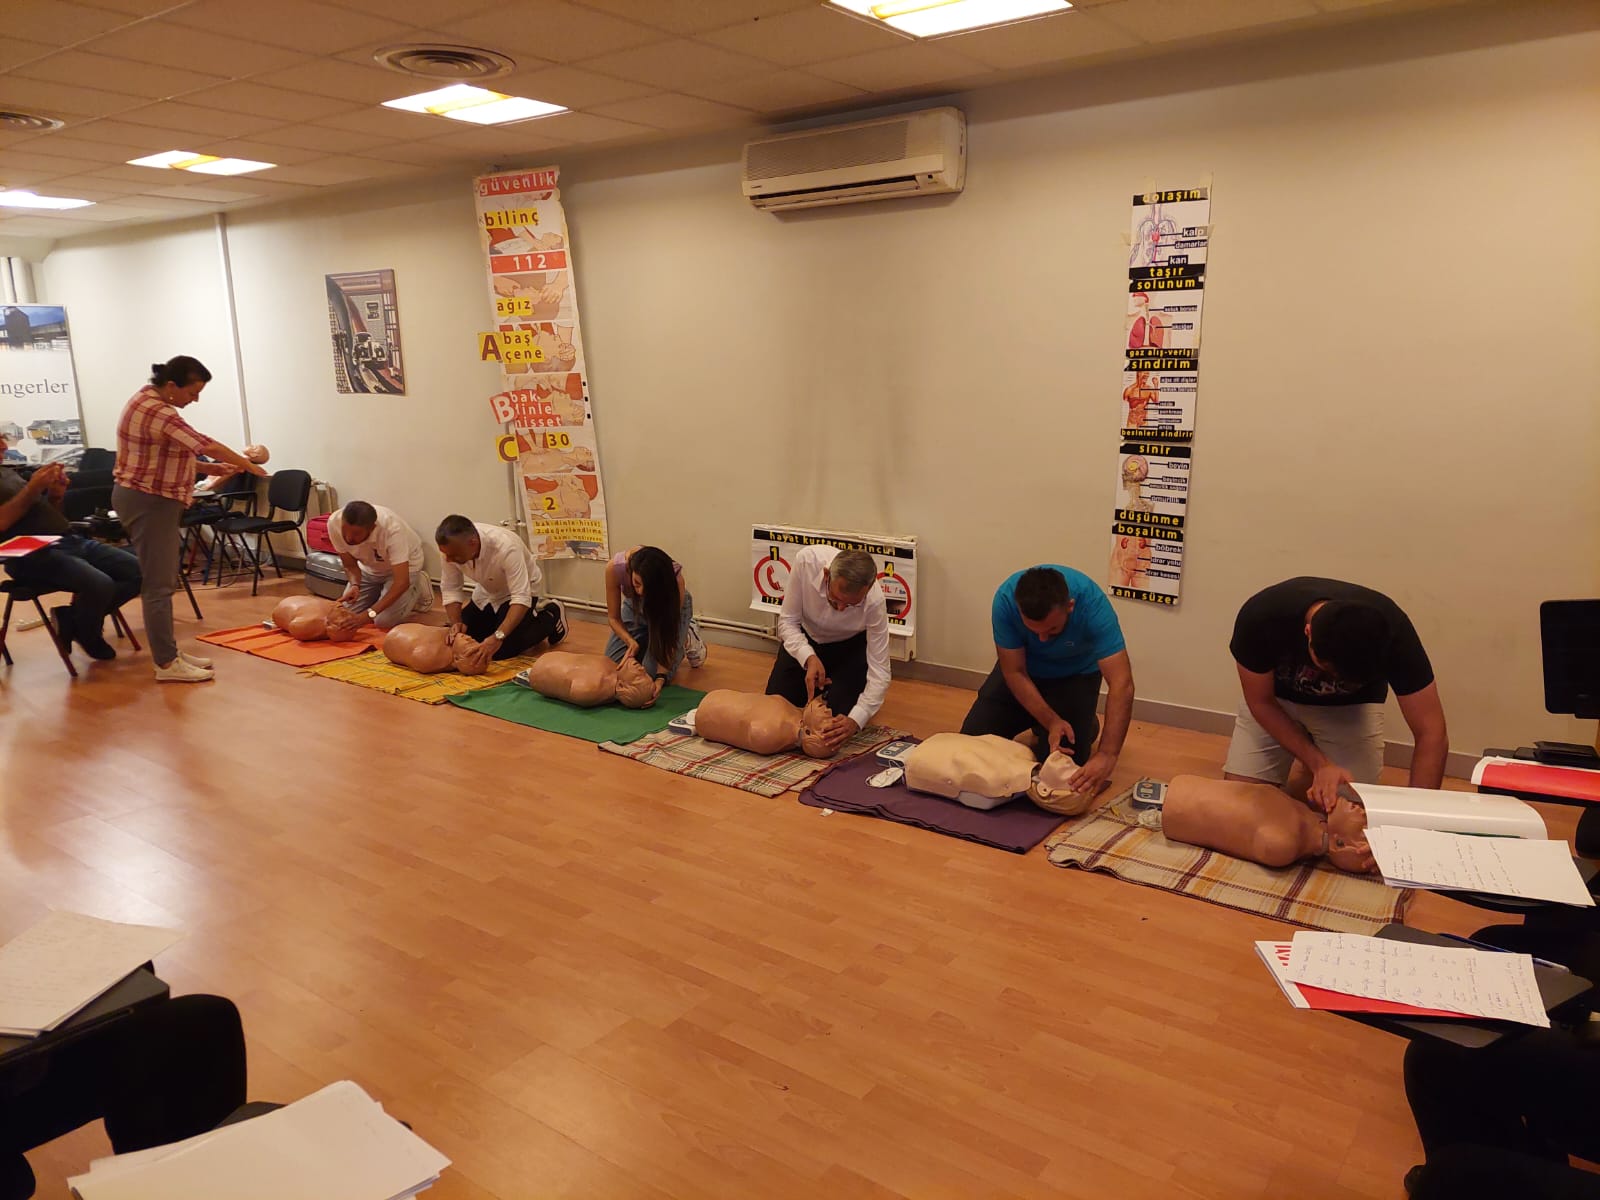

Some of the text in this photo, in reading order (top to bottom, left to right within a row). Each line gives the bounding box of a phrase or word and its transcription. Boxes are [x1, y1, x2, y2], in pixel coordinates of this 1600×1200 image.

[480, 172, 555, 196] güvenlik
[1143, 189, 1200, 203] dolaşım
[484, 210, 539, 227] bilinç
[1183, 227, 1204, 237] kalp
[513, 254, 547, 271] 112
[1169, 256, 1187, 265] kan
[1150, 267, 1184, 279] taşır
[1137, 279, 1196, 290] solunum
[497, 298, 531, 314] ağız
[503, 333, 531, 347] baş
[481, 335, 502, 361] A
[1129, 350, 1144, 358] gaz
[505, 349, 542, 363] çene
[1132, 359, 1190, 369] sindirim
[509, 390, 540, 403] bak
[492, 396, 515, 424] B
[547, 433, 570, 447] 30
[1121, 429, 1193, 438] besinleri sindirir
[498, 436, 518, 461] C
[1139, 444, 1171, 455] sinir
[545, 497, 557, 511] 2
[1120, 510, 1179, 525] düşünme
[1118, 523, 1177, 539] boşaltım
[769, 531, 799, 544] hayat
[803, 535, 853, 551] kurtarma
[771, 547, 778, 561] 1
[884, 562, 894, 577] 4
[766, 596, 779, 605] 112
